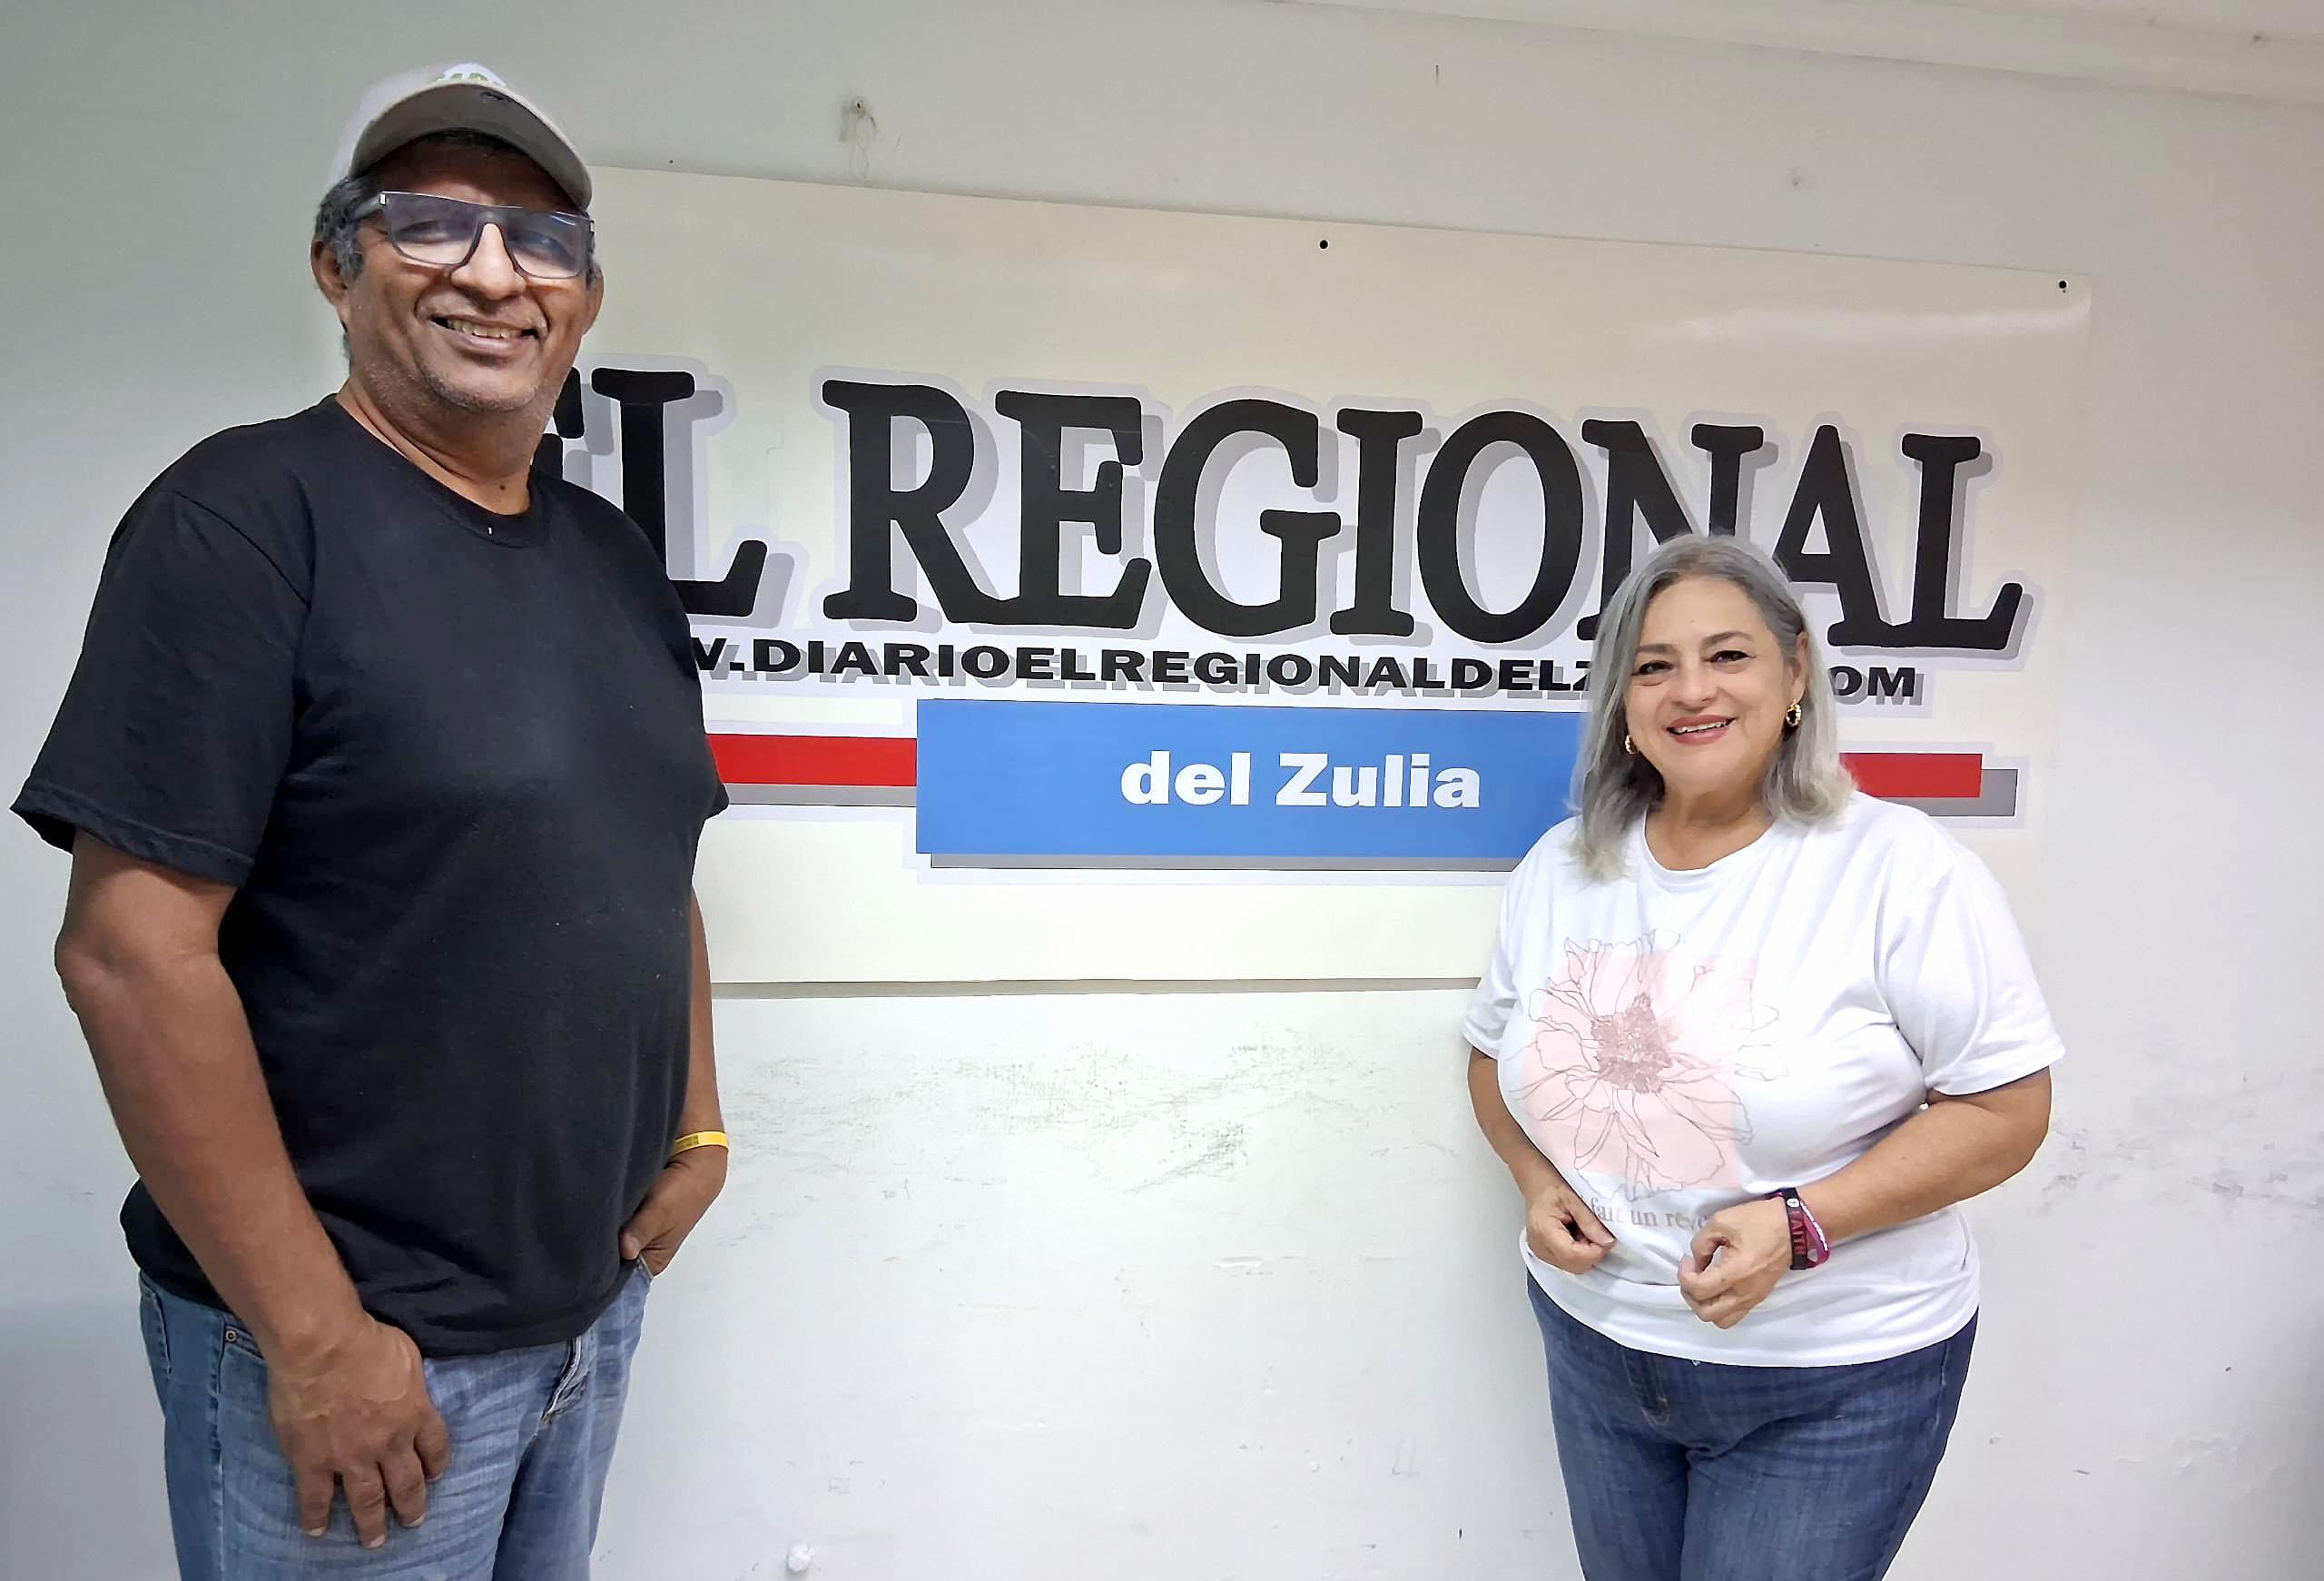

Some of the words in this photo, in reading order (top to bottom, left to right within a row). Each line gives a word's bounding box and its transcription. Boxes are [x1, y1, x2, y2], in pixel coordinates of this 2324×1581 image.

[532, 366, 768, 618] L
[822, 380, 2024, 652] REGIONAL
[1119, 749, 1252, 806] del
[1275, 752, 1482, 809] Zulia
[1630, 1208, 1658, 1228] un
